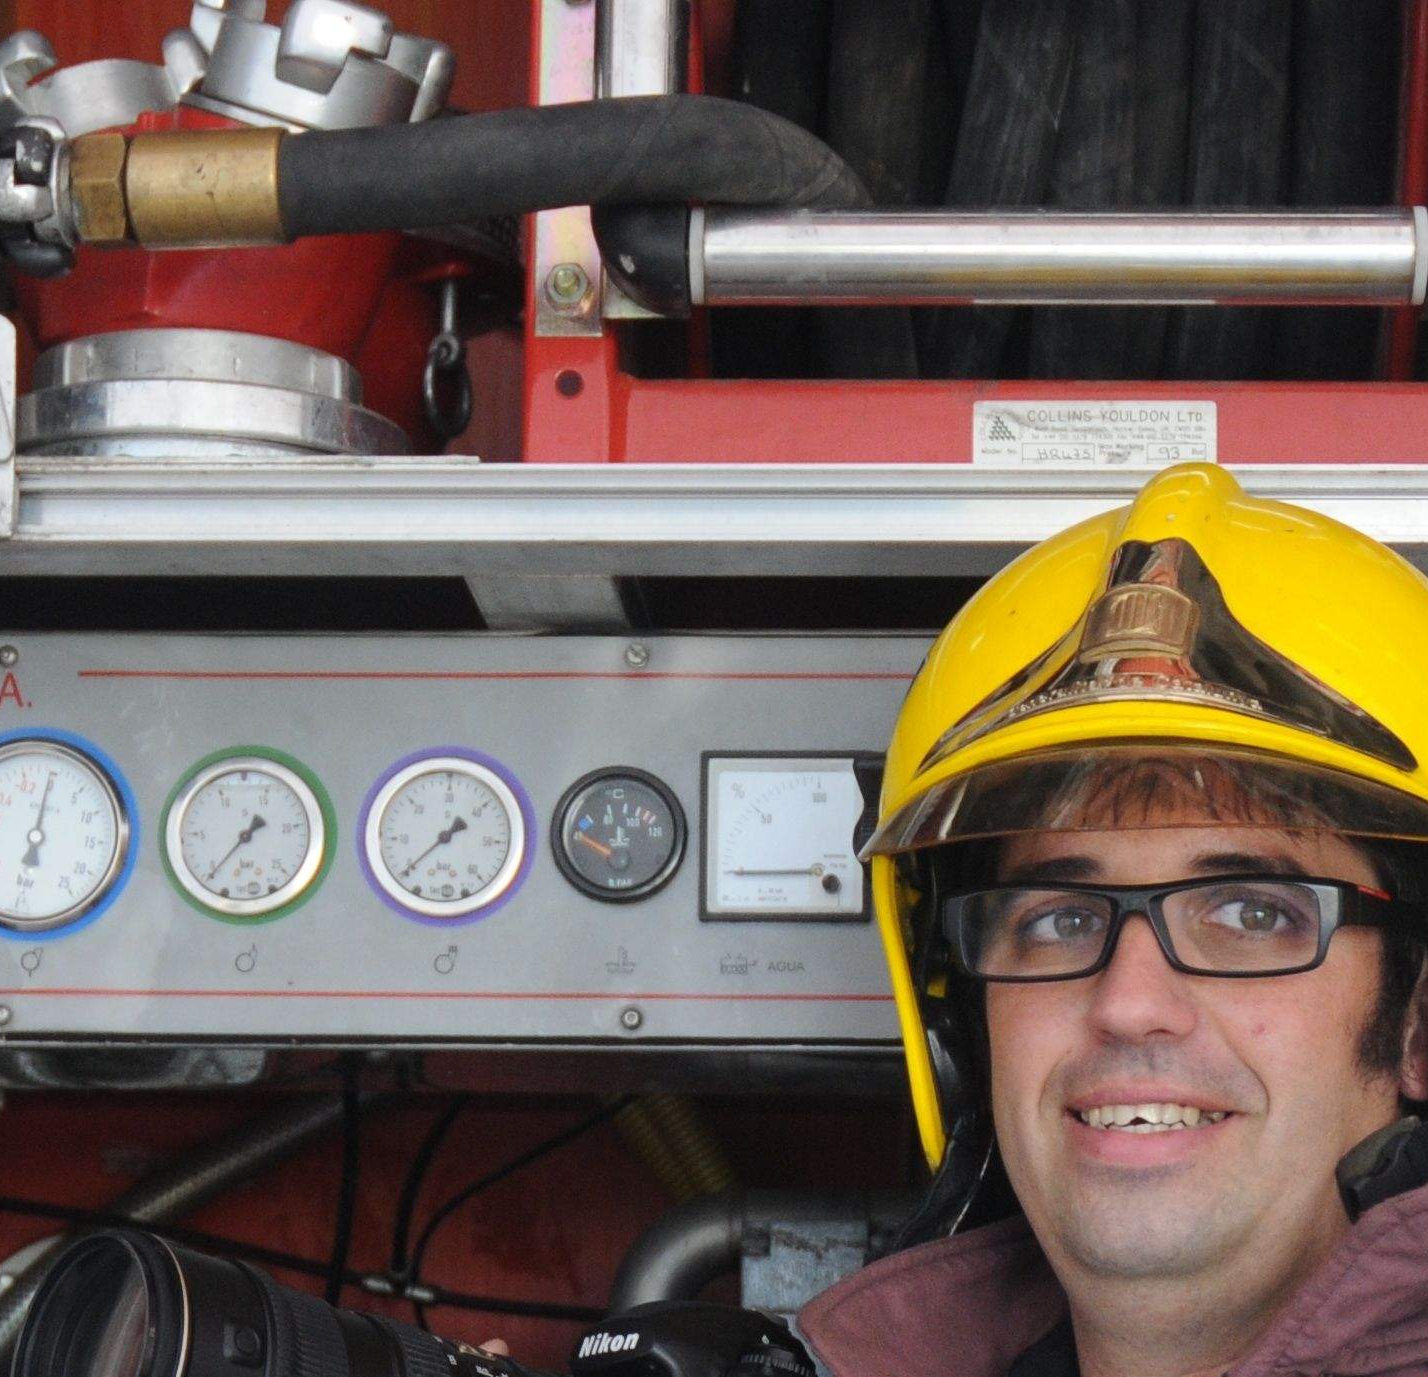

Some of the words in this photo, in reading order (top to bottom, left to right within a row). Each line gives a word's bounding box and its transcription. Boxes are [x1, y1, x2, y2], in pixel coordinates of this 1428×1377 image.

[1026, 410, 1093, 423] COLLINS
[1100, 410, 1170, 423] YOULDON
[1158, 446, 1180, 460] 93
[812, 792, 828, 804] 100
[80, 811, 92, 824] 10
[84, 835, 96, 849] 15
[16, 874, 35, 888] bar
[57, 876, 70, 889] 25
[766, 960, 806, 973] AGUA
[578, 1332, 640, 1359] Nikon
